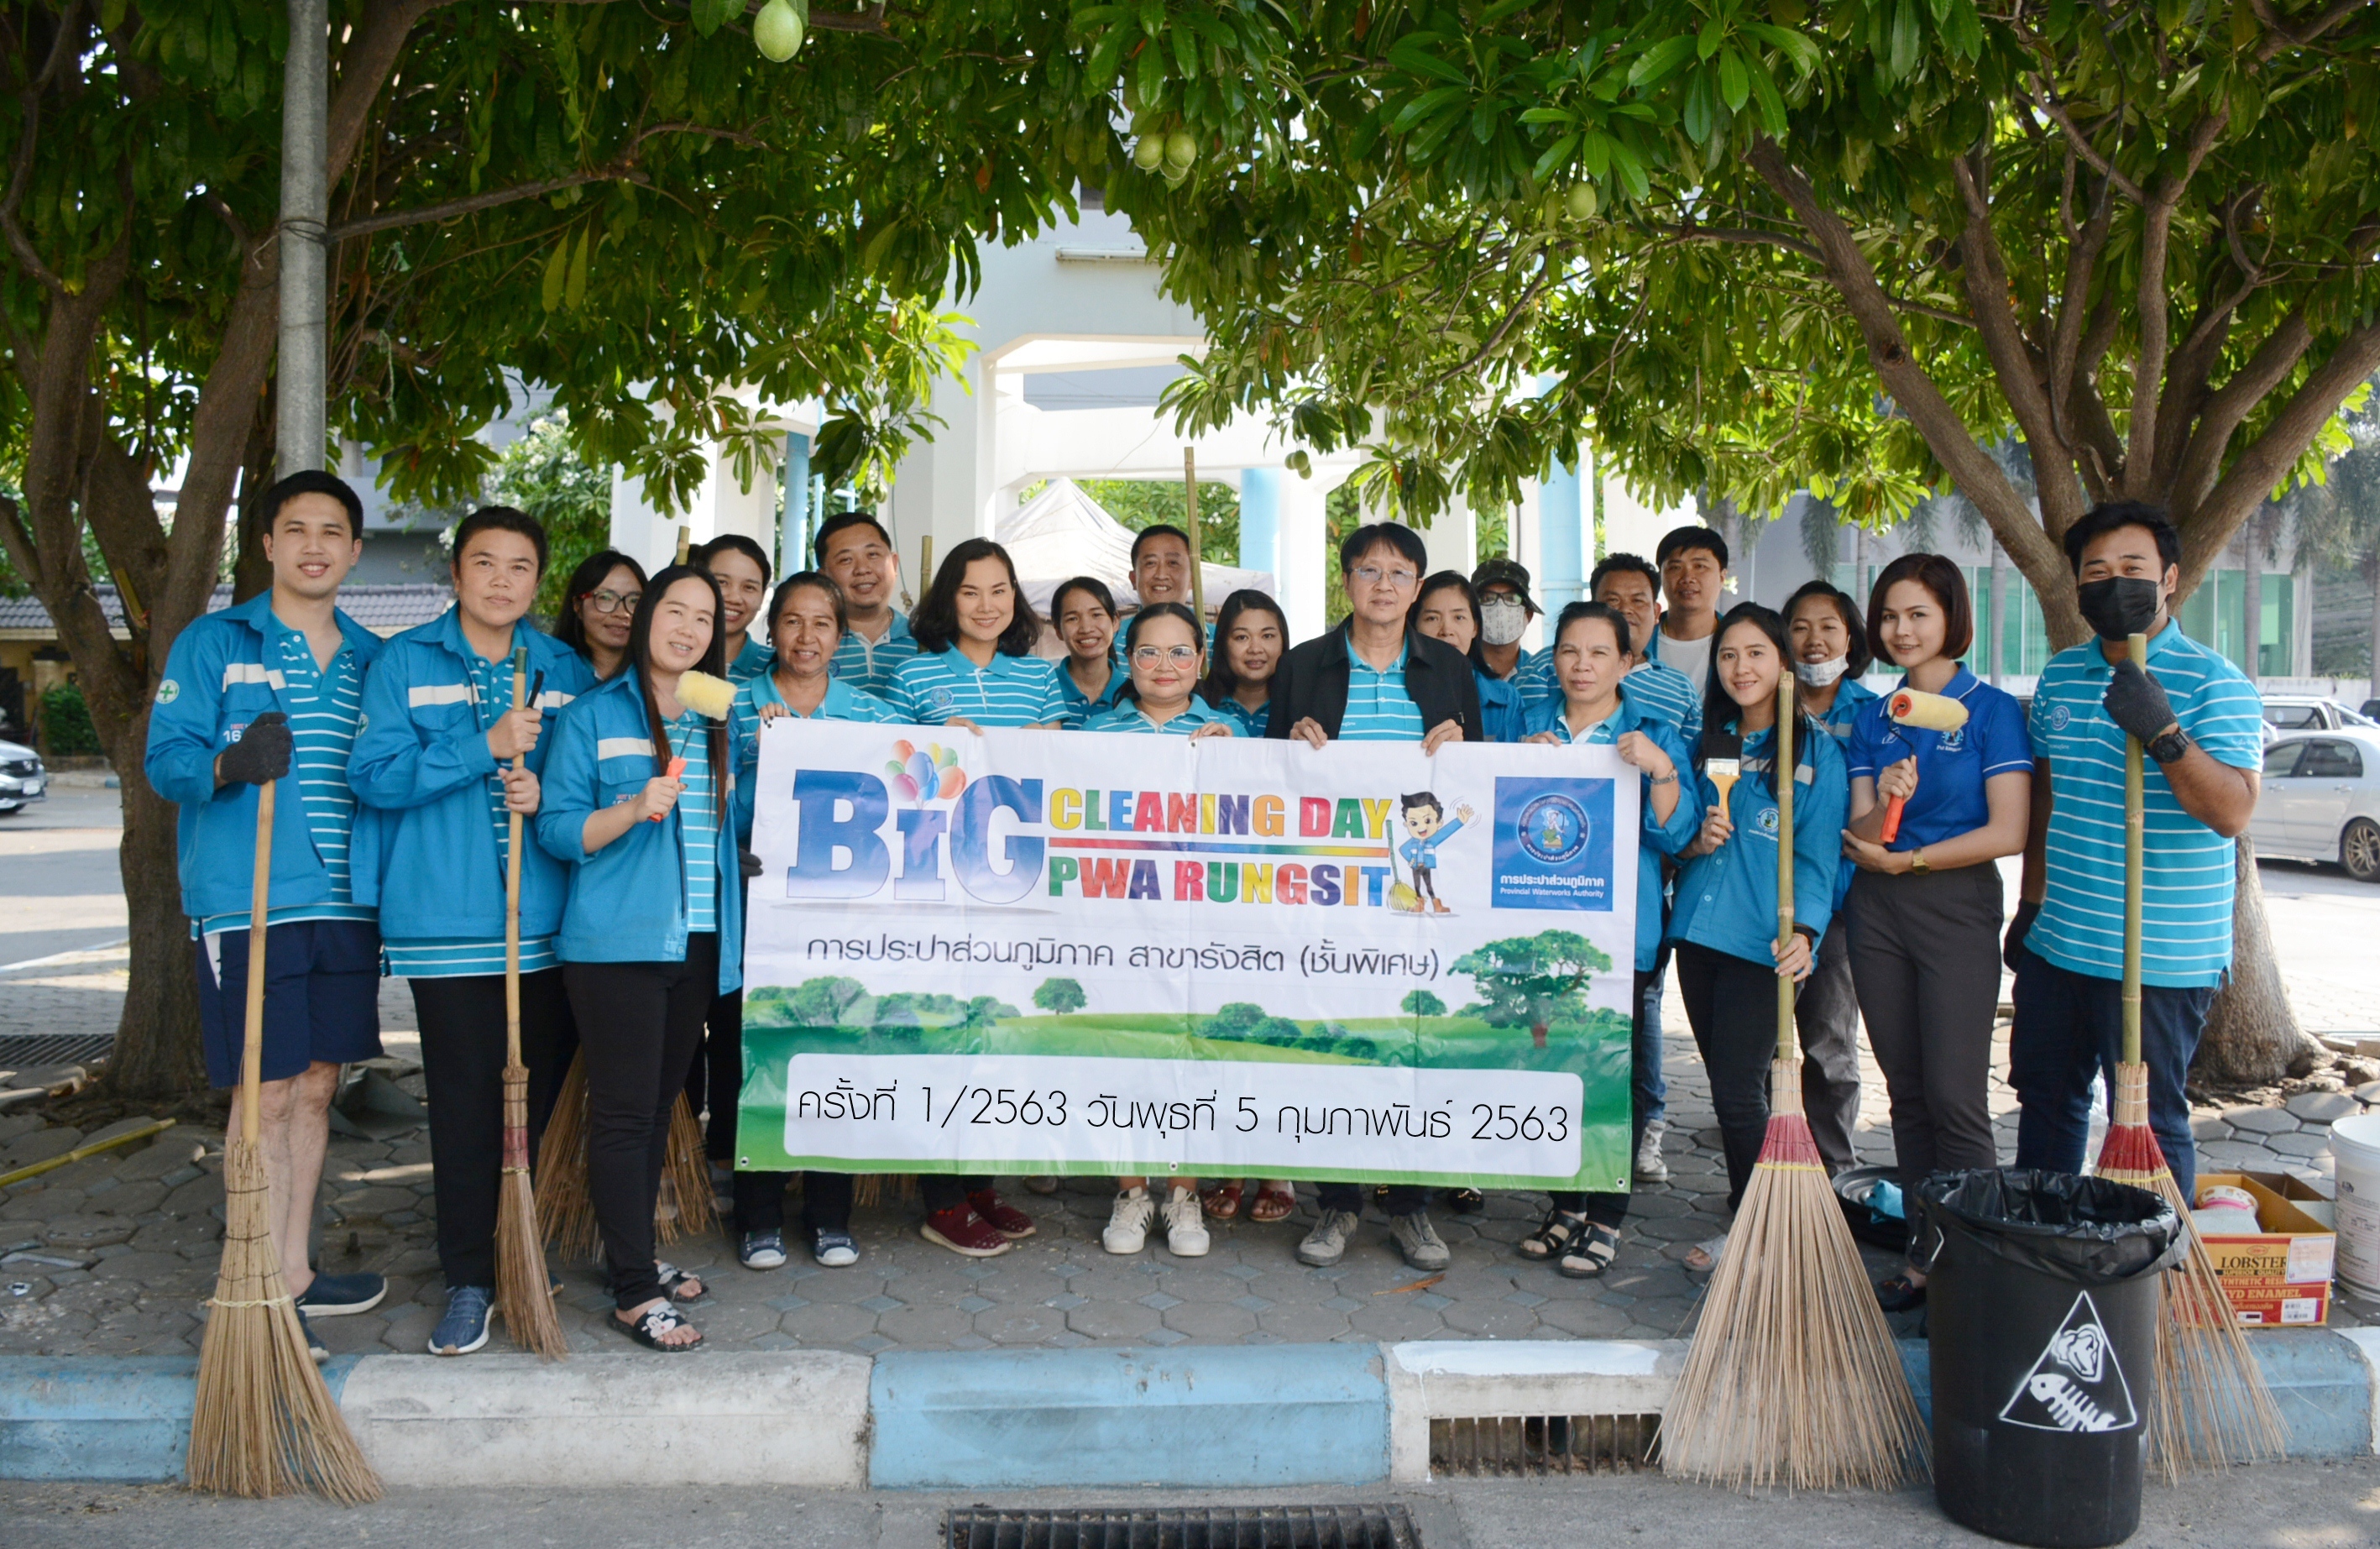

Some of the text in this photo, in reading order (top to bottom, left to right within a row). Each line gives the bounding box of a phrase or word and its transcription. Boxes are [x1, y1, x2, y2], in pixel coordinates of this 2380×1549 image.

[1049, 788, 1393, 840] CLEANING DAY
[1049, 857, 1391, 908] PWA RUNGSIT
[1500, 874, 1604, 888] การประปาส่วนภูมิภาค
[1500, 887, 1604, 898] Provincial Waterworks Authority
[807, 933, 1440, 981] การประปาส่วนภูมิภาค สาขารังสิต (ชั้นพิเศษ)
[798, 1078, 1568, 1143] ครั้งที่ 1/2563 วันพุธที่ 5 กุมภาพันธ์ 2563
[2247, 1289, 2302, 1300] ENAMEL
